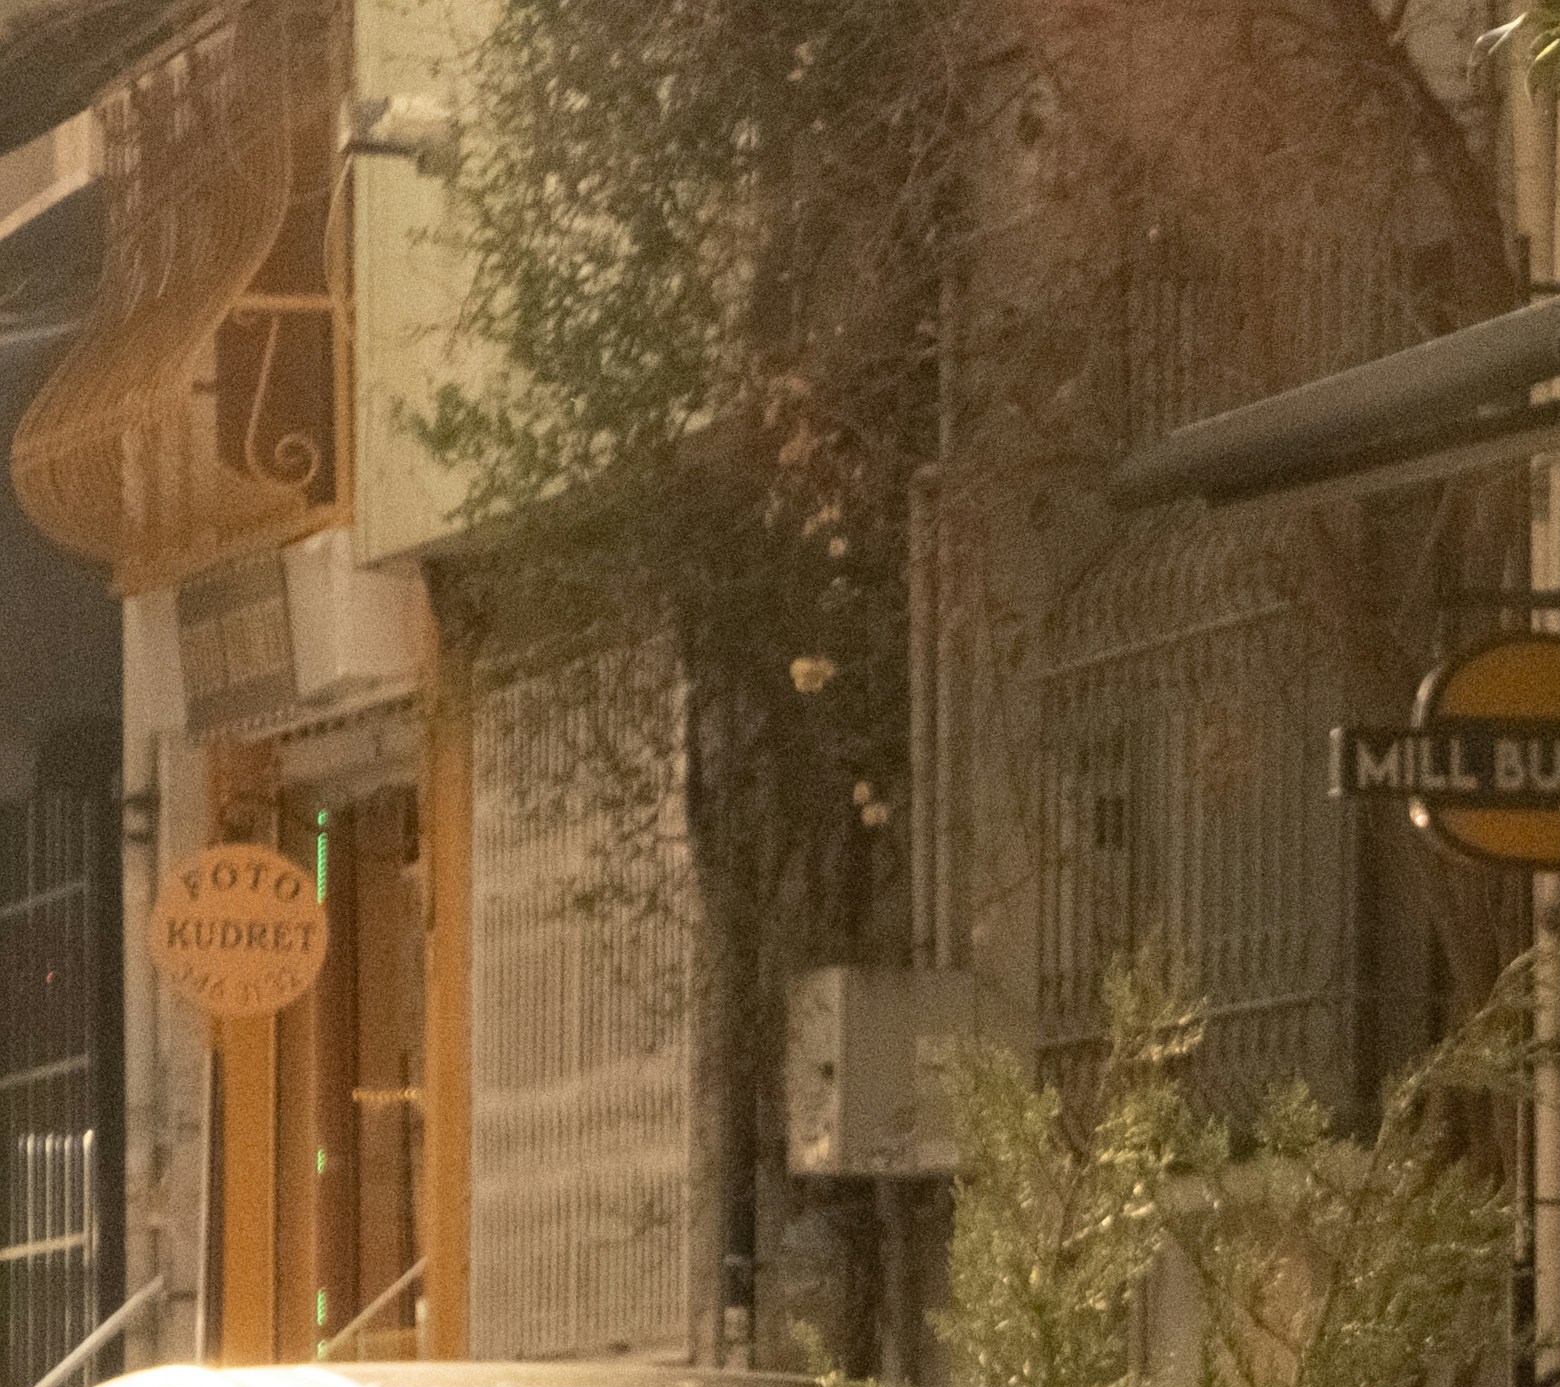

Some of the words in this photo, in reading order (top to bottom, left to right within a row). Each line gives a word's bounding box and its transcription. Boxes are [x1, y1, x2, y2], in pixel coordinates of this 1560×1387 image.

[1356, 737, 1478, 789] MILL
[179, 861, 301, 902] FOTO
[166, 919, 315, 953] KUDRET
